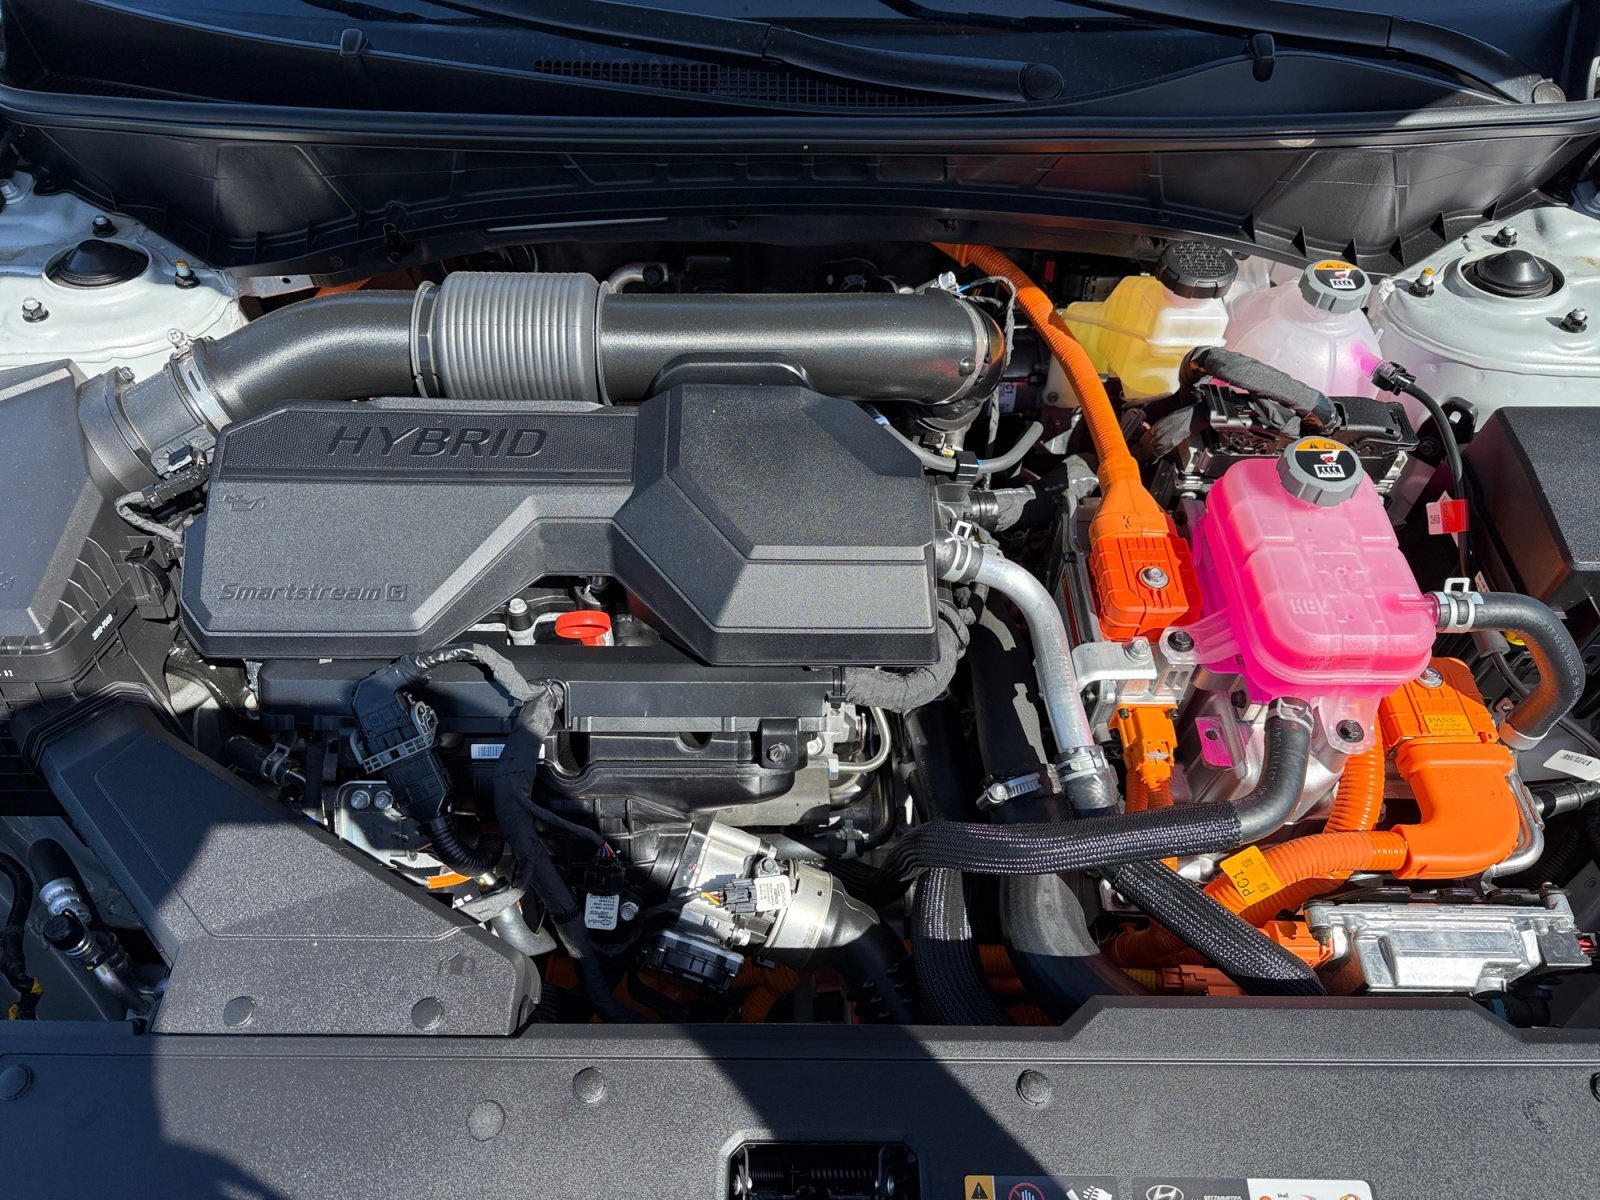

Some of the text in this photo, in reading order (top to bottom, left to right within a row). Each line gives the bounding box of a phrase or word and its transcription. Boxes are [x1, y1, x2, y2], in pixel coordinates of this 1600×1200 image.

[327, 426, 547, 457] HYBRID
[217, 584, 408, 601] Smartstream G
[1232, 870, 1256, 897] PC1
